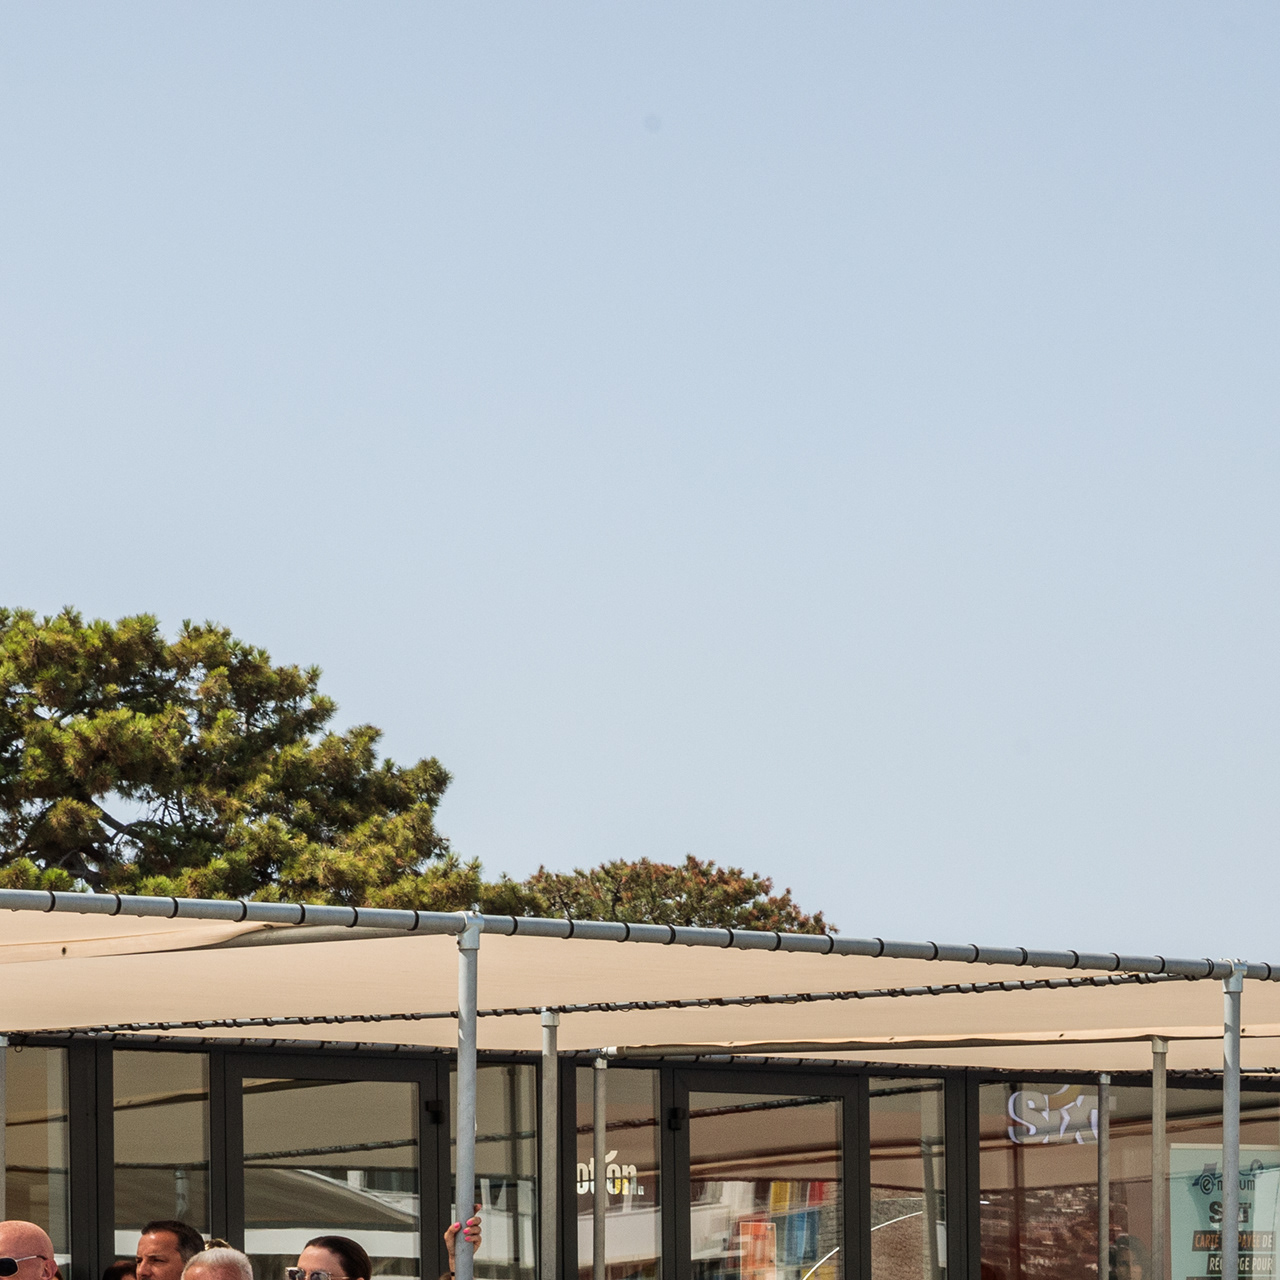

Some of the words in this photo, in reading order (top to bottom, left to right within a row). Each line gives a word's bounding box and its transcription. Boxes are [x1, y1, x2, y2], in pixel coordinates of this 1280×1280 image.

[1194, 1234, 1219, 1248] CARTE
[1262, 1235, 1273, 1247] DE
[1252, 1257, 1273, 1271] POUR
